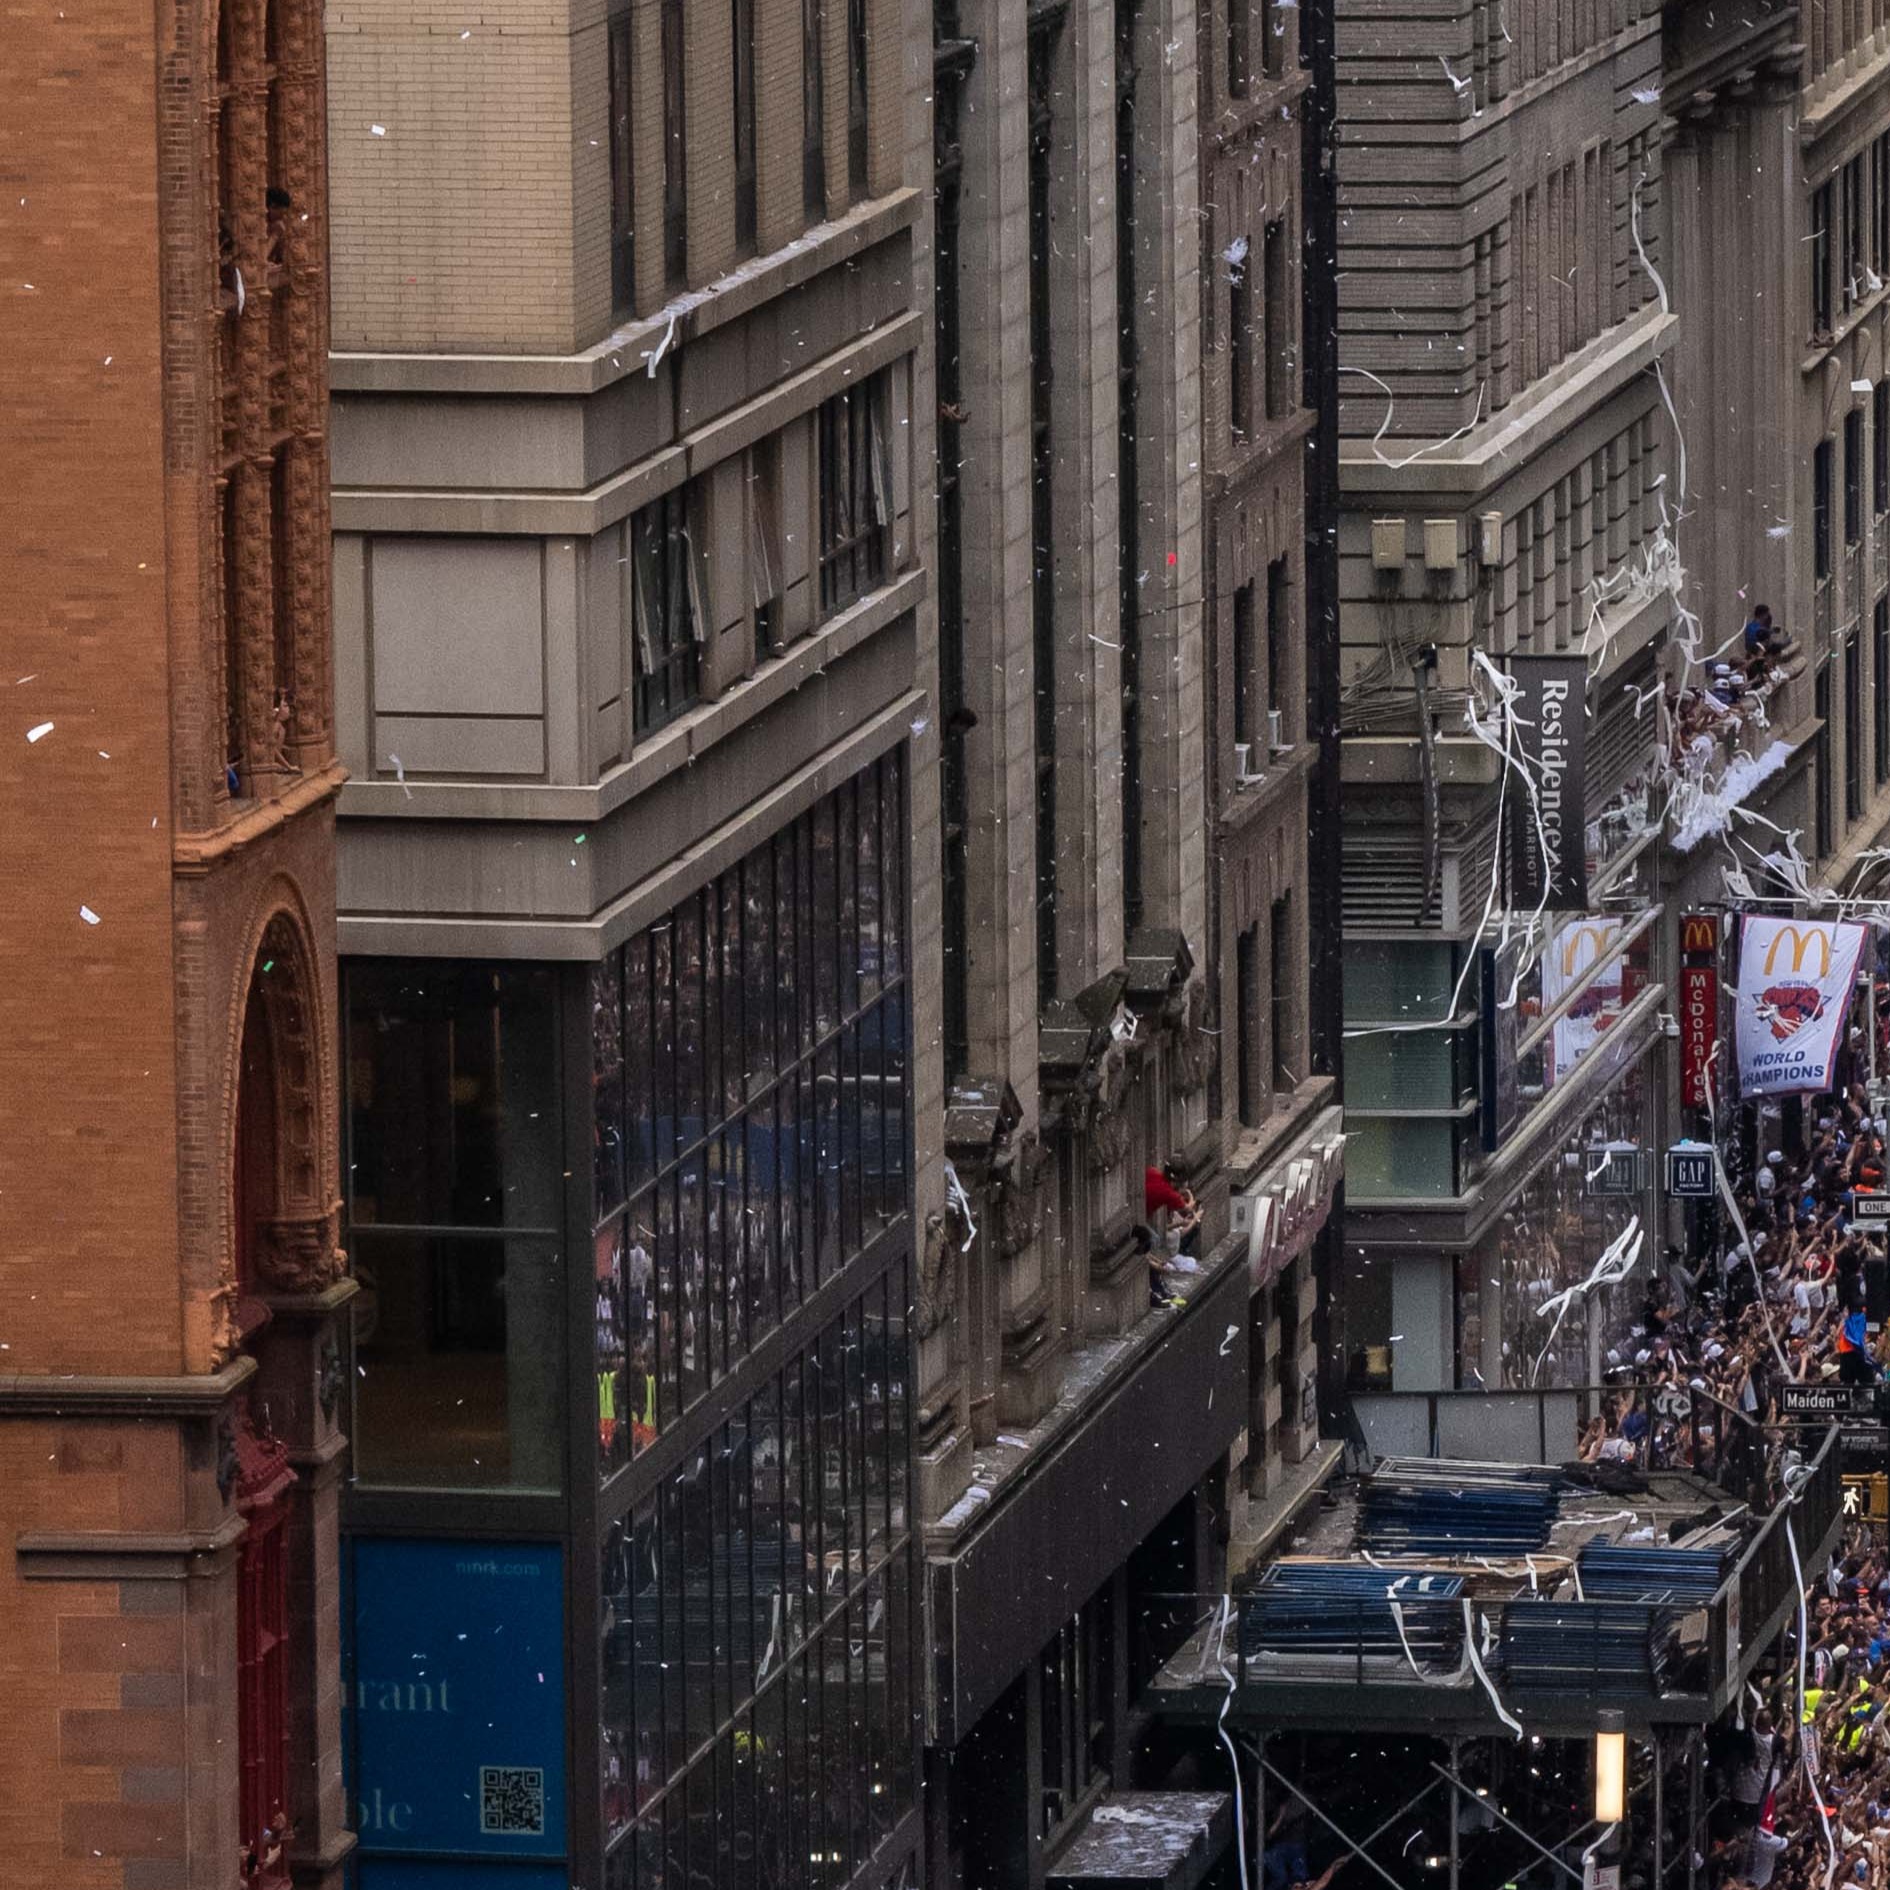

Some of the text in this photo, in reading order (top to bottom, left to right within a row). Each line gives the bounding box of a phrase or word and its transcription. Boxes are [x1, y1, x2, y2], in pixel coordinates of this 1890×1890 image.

[1541, 679, 1569, 849] Residence
[1526, 814, 1538, 888] MARRIOTT
[1753, 1051, 1807, 1068] WORLD
[1679, 1161, 1705, 1183] GAP
[1865, 1202, 1887, 1212] ONE
[1786, 1394, 1835, 1409] Maiden
